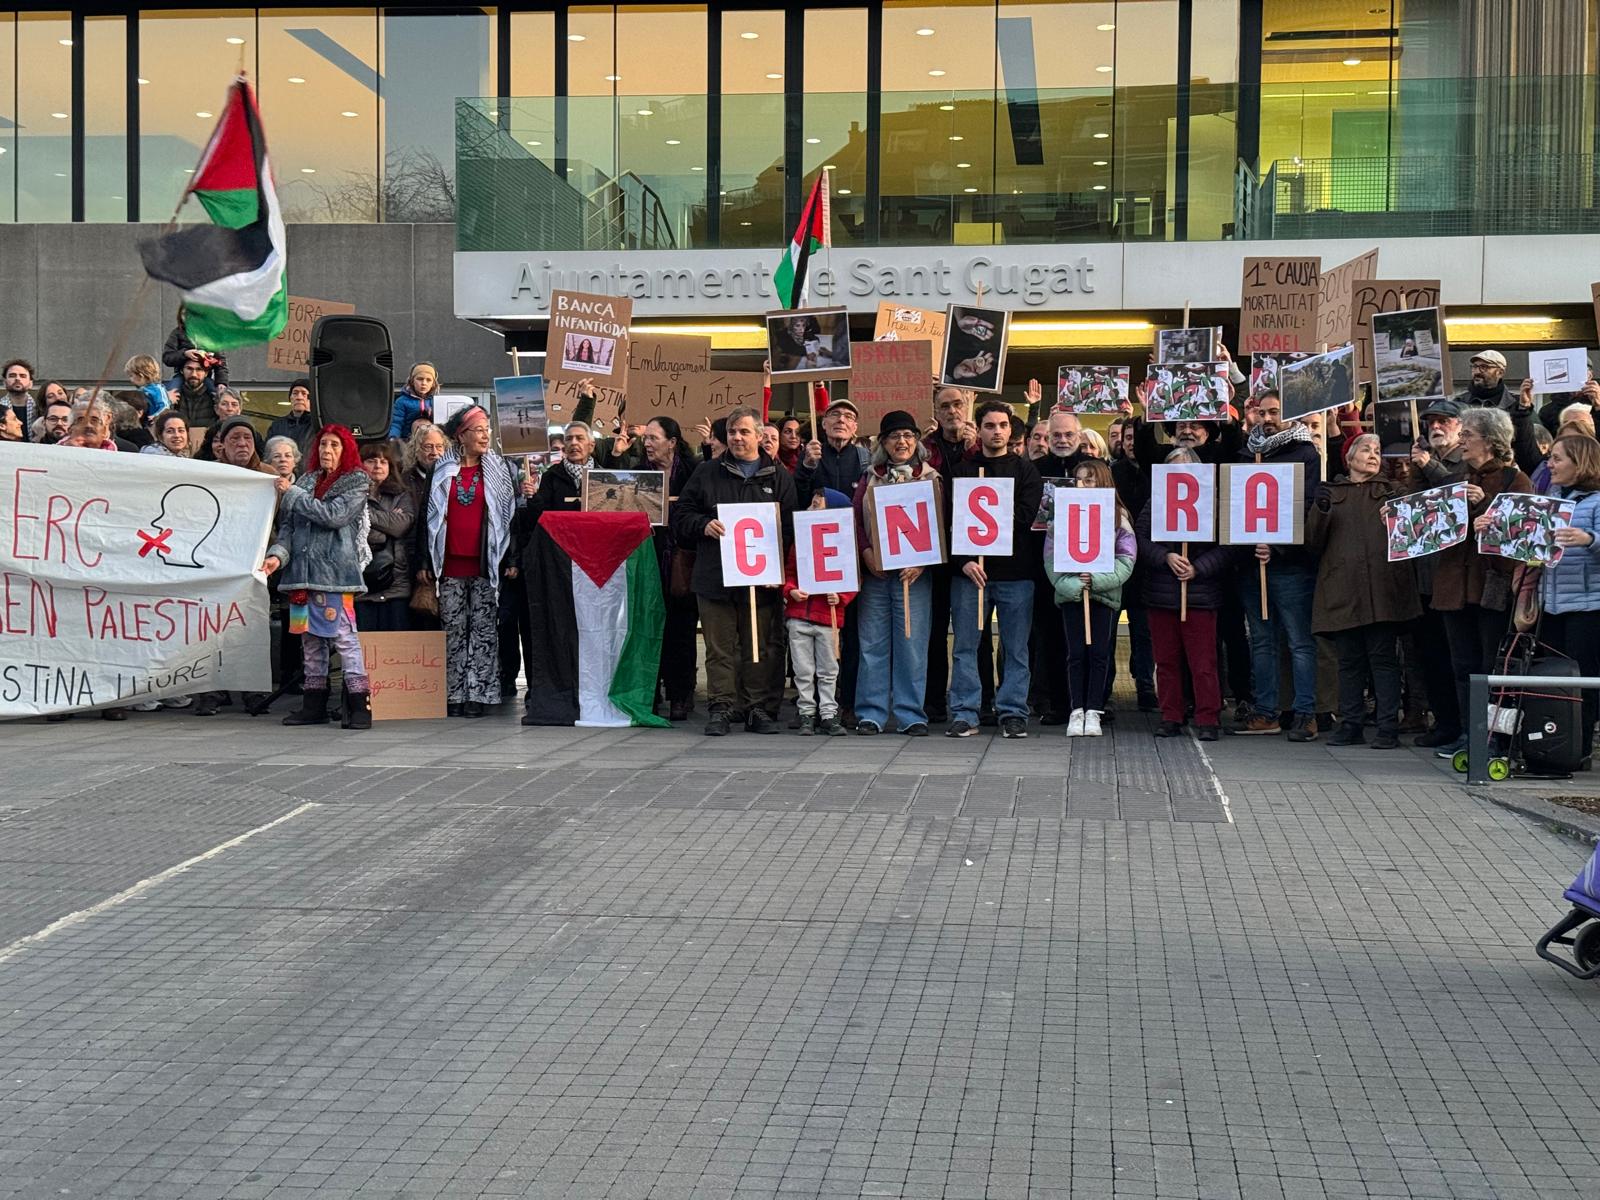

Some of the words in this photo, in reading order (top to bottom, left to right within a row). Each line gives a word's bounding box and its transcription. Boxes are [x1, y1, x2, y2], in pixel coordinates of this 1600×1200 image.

[510, 258, 770, 310] Ajuntament
[850, 257, 951, 297] Sant
[963, 255, 1095, 306] Cugat
[1275, 261, 1319, 287] CAUSA
[288, 302, 322, 322] FORA
[558, 295, 615, 319] BANCA
[1243, 292, 1316, 312] MORTALITAT
[1355, 285, 1440, 327] BOCOT
[1315, 303, 1352, 344] ISR
[1244, 332, 1301, 352] ISRAEL
[650, 384, 688, 409] JA!
[13, 468, 109, 568] ERC
[0, 572, 58, 638] EN
